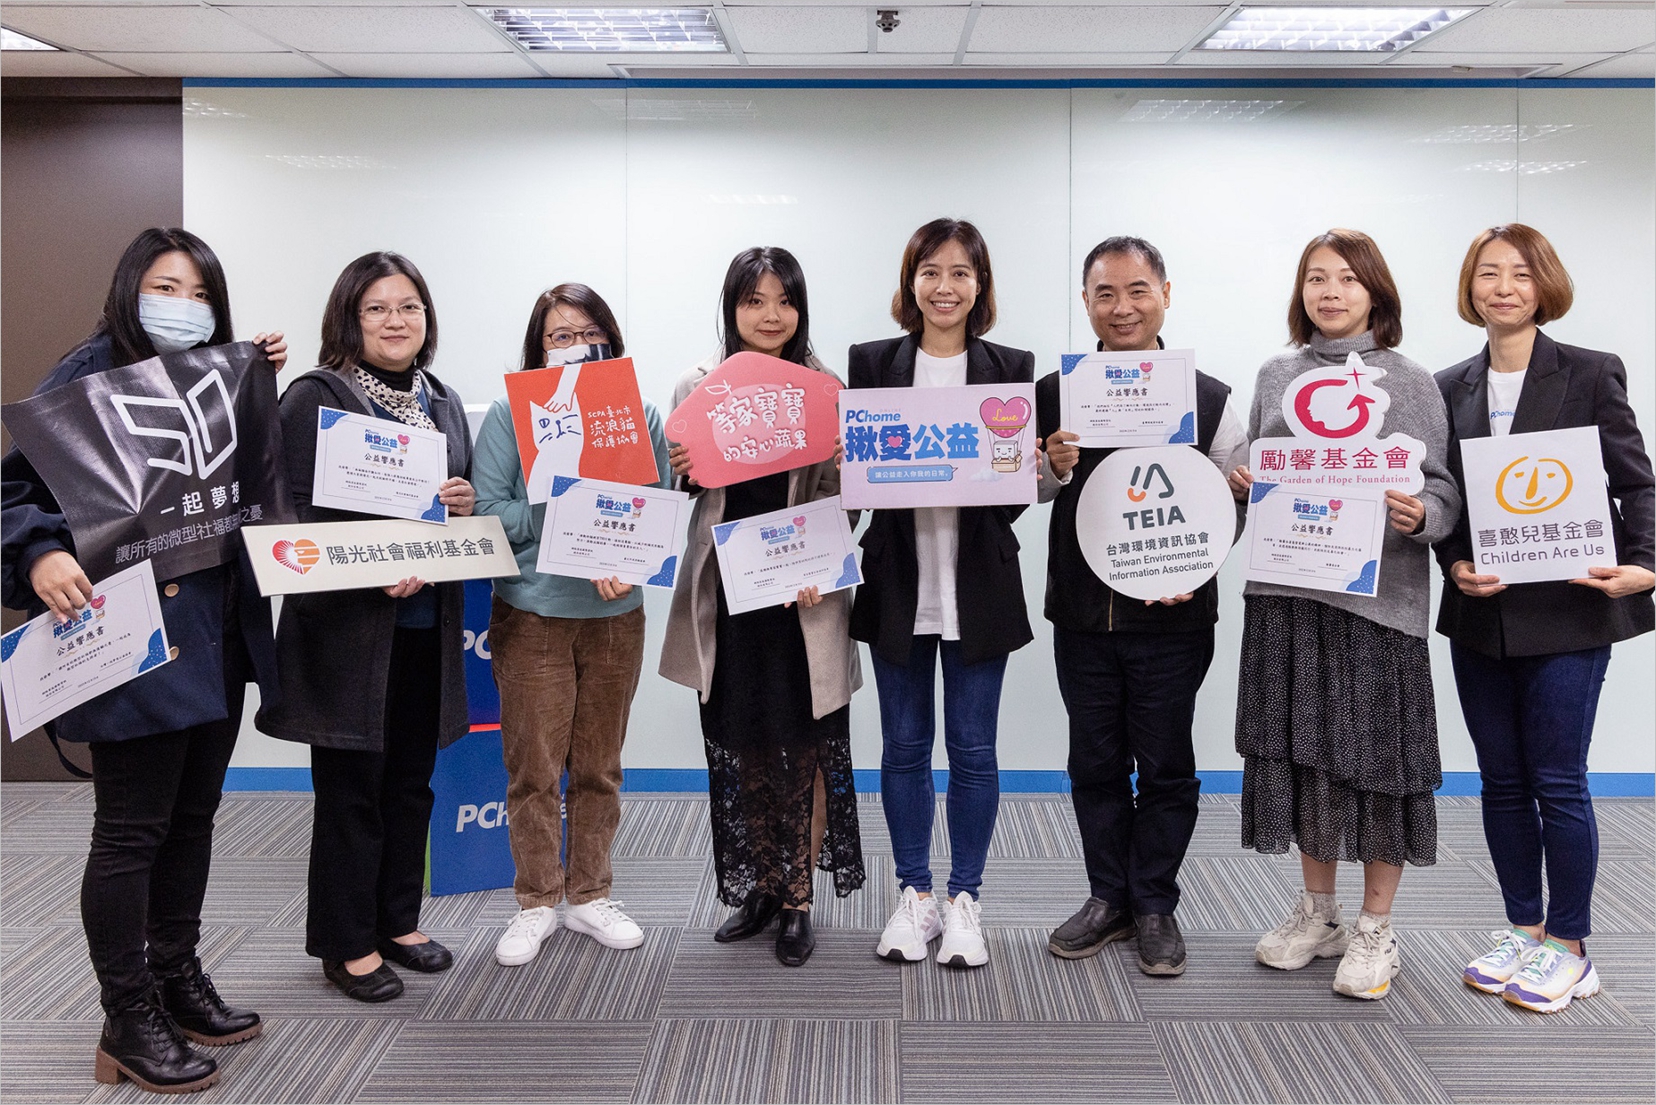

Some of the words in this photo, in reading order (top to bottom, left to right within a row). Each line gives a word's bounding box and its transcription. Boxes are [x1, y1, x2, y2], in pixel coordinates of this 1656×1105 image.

[845, 409, 901, 423] PChome
[992, 408, 1019, 422] Love
[723, 428, 808, 462] 的安心蔬果
[845, 422, 980, 463] 揪愛公益
[1260, 446, 1411, 471] 勵馨基金會
[1279, 474, 1312, 484] Garden
[1315, 475, 1326, 484] of
[1328, 475, 1353, 486] Hope
[1356, 474, 1410, 483] Foundation
[1122, 505, 1186, 531] TEIA
[1106, 531, 1209, 556] 台灣環境資訊協會
[1478, 519, 1603, 548] 喜憨兒基金會
[326, 537, 495, 565] 陽光社會福利基金會
[1111, 557, 1142, 568] Taiwan
[1143, 548, 1209, 564] Environmental
[1480, 550, 1548, 565] Children
[1552, 546, 1579, 559] Are
[1583, 544, 1605, 556] Us
[1109, 568, 1160, 581] Information
[1162, 561, 1214, 574] Association
